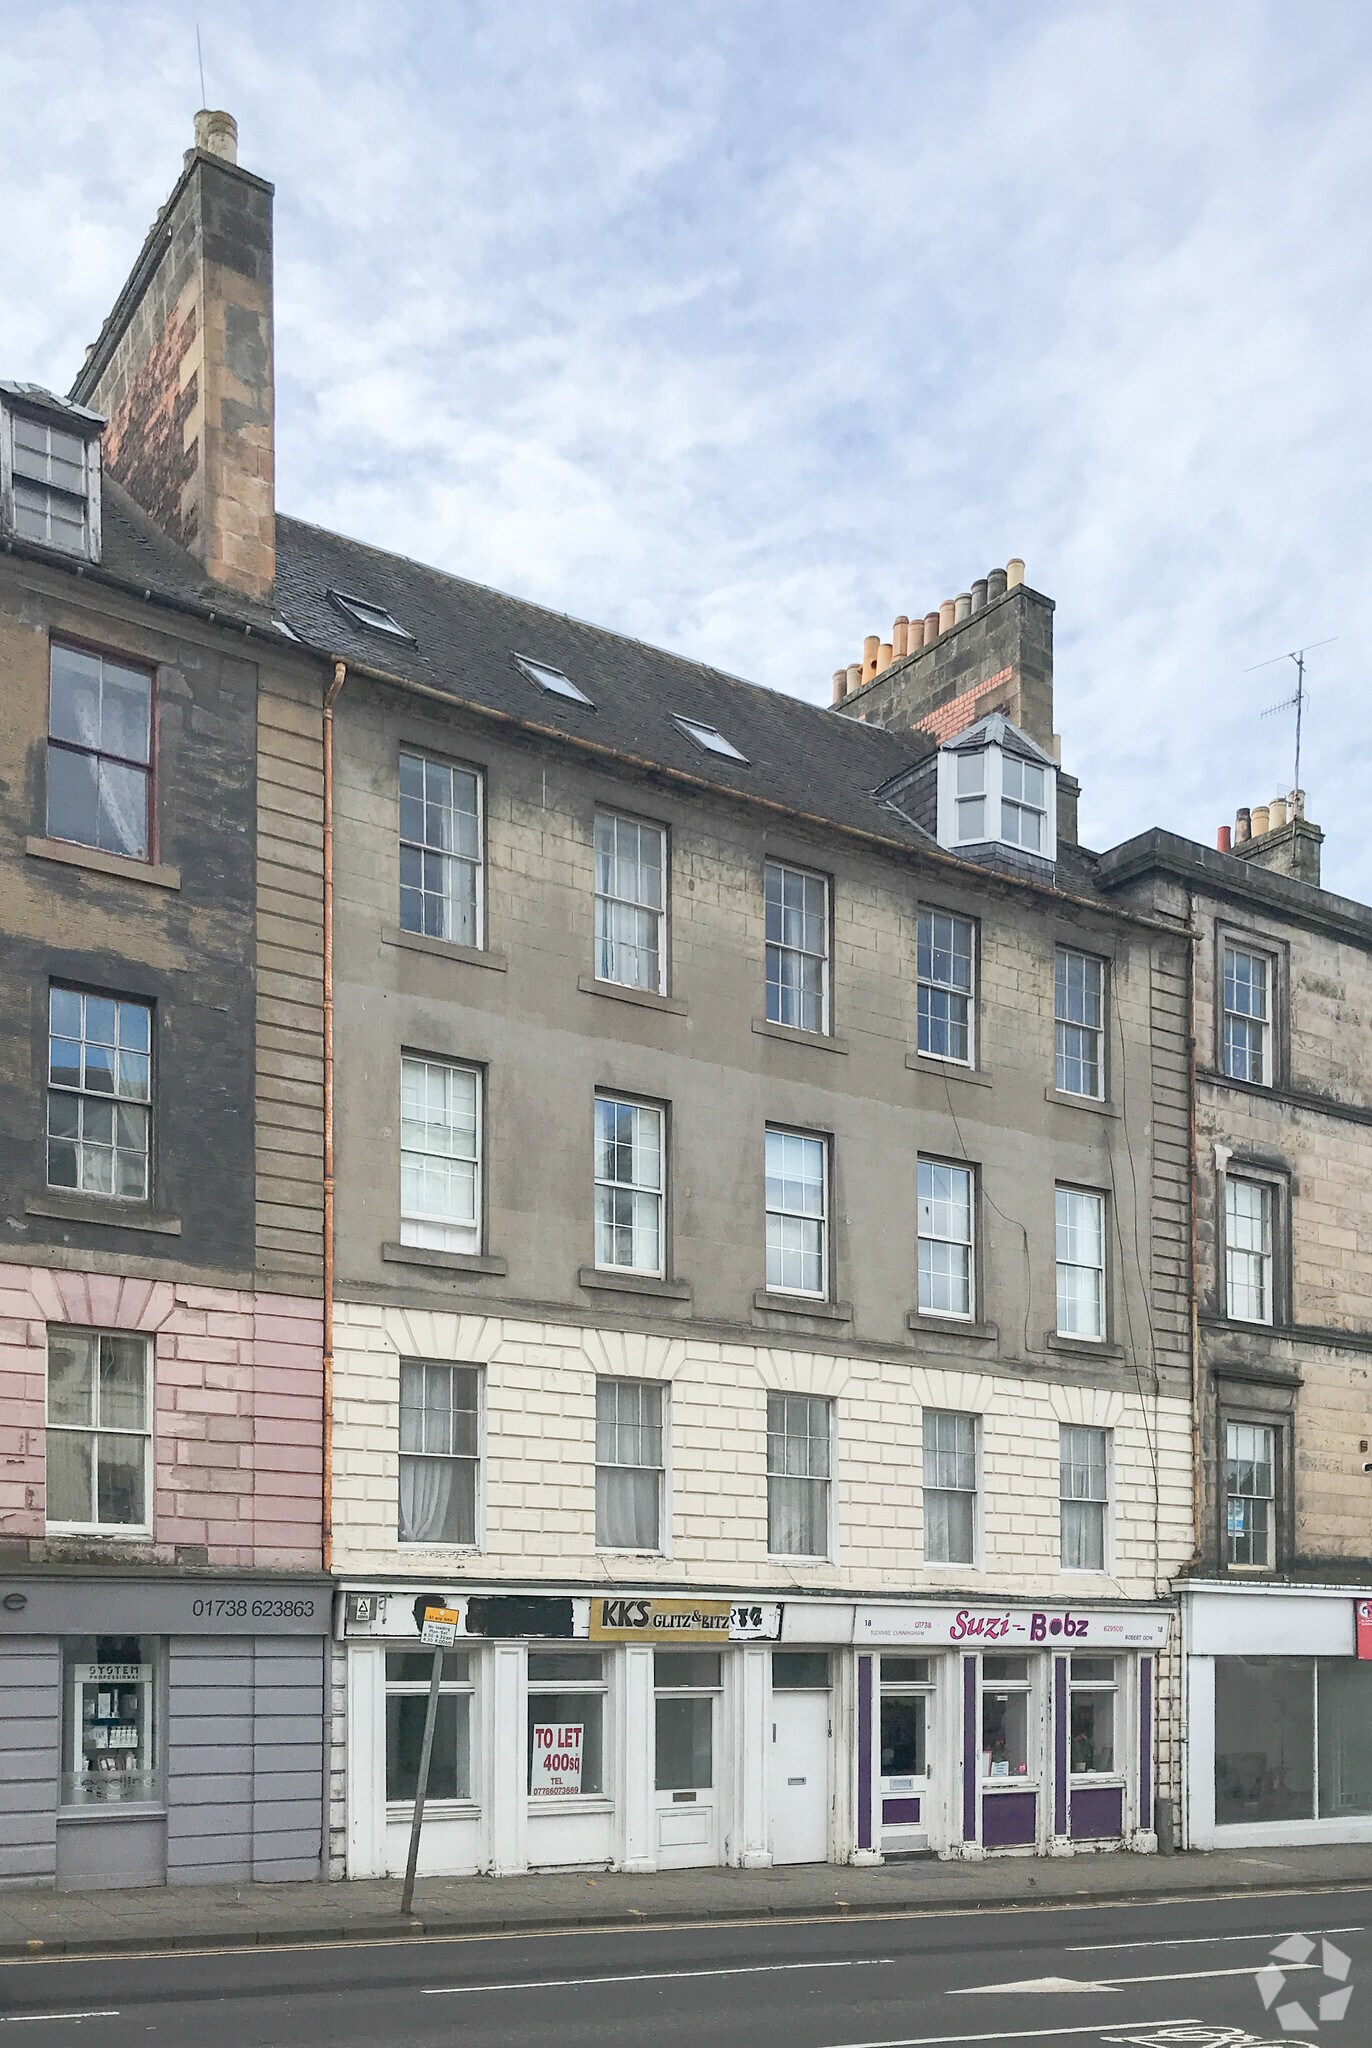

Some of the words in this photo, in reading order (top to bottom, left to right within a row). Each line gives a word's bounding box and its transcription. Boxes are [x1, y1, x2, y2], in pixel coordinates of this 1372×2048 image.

[193, 1600, 247, 1617] 01738
[251, 1600, 314, 1617] 623863
[914, 1621, 932, 1629] 01738
[89, 1666, 139, 1675] SYSTEM
[535, 1728, 553, 1748] TO
[558, 1728, 582, 1748] LET
[550, 1777, 563, 1785] TEL
